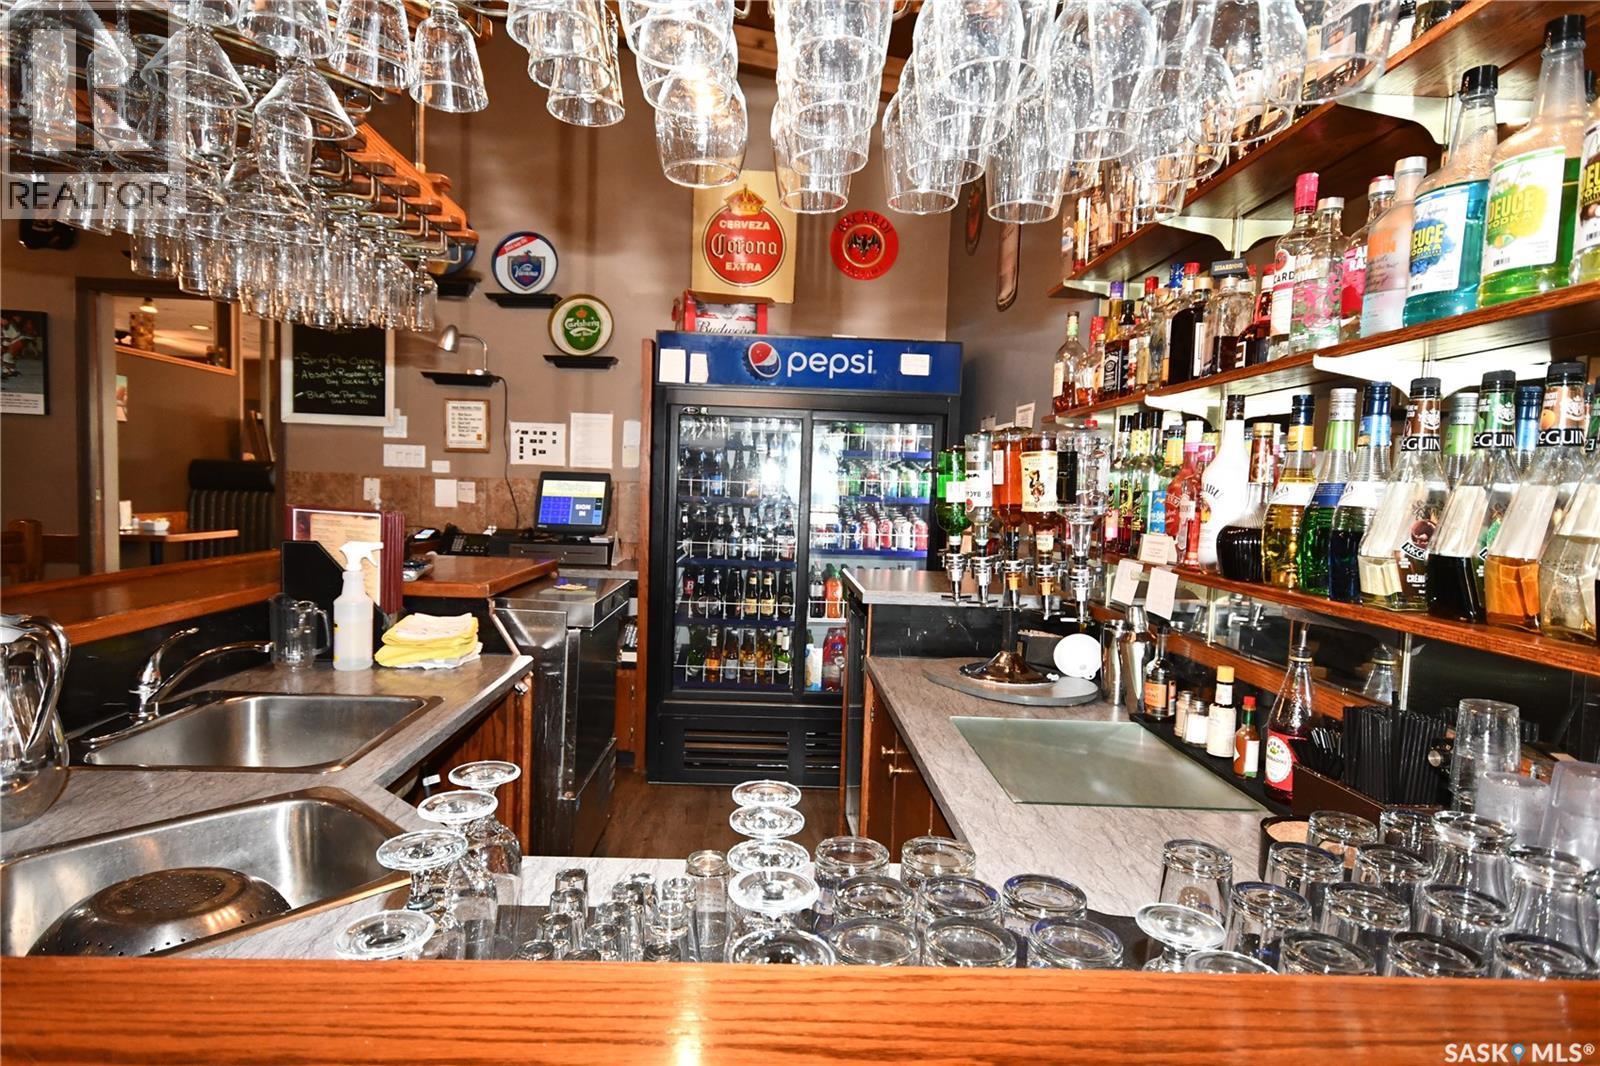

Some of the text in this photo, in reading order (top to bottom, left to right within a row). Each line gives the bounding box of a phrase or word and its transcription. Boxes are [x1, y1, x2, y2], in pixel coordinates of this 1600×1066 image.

[719, 219, 770, 231] CERVEZA
[711, 232, 777, 259] Corona
[725, 262, 762, 272] EXTRA
[565, 317, 600, 332] Carlsberg
[787, 349, 874, 379] pepsi
